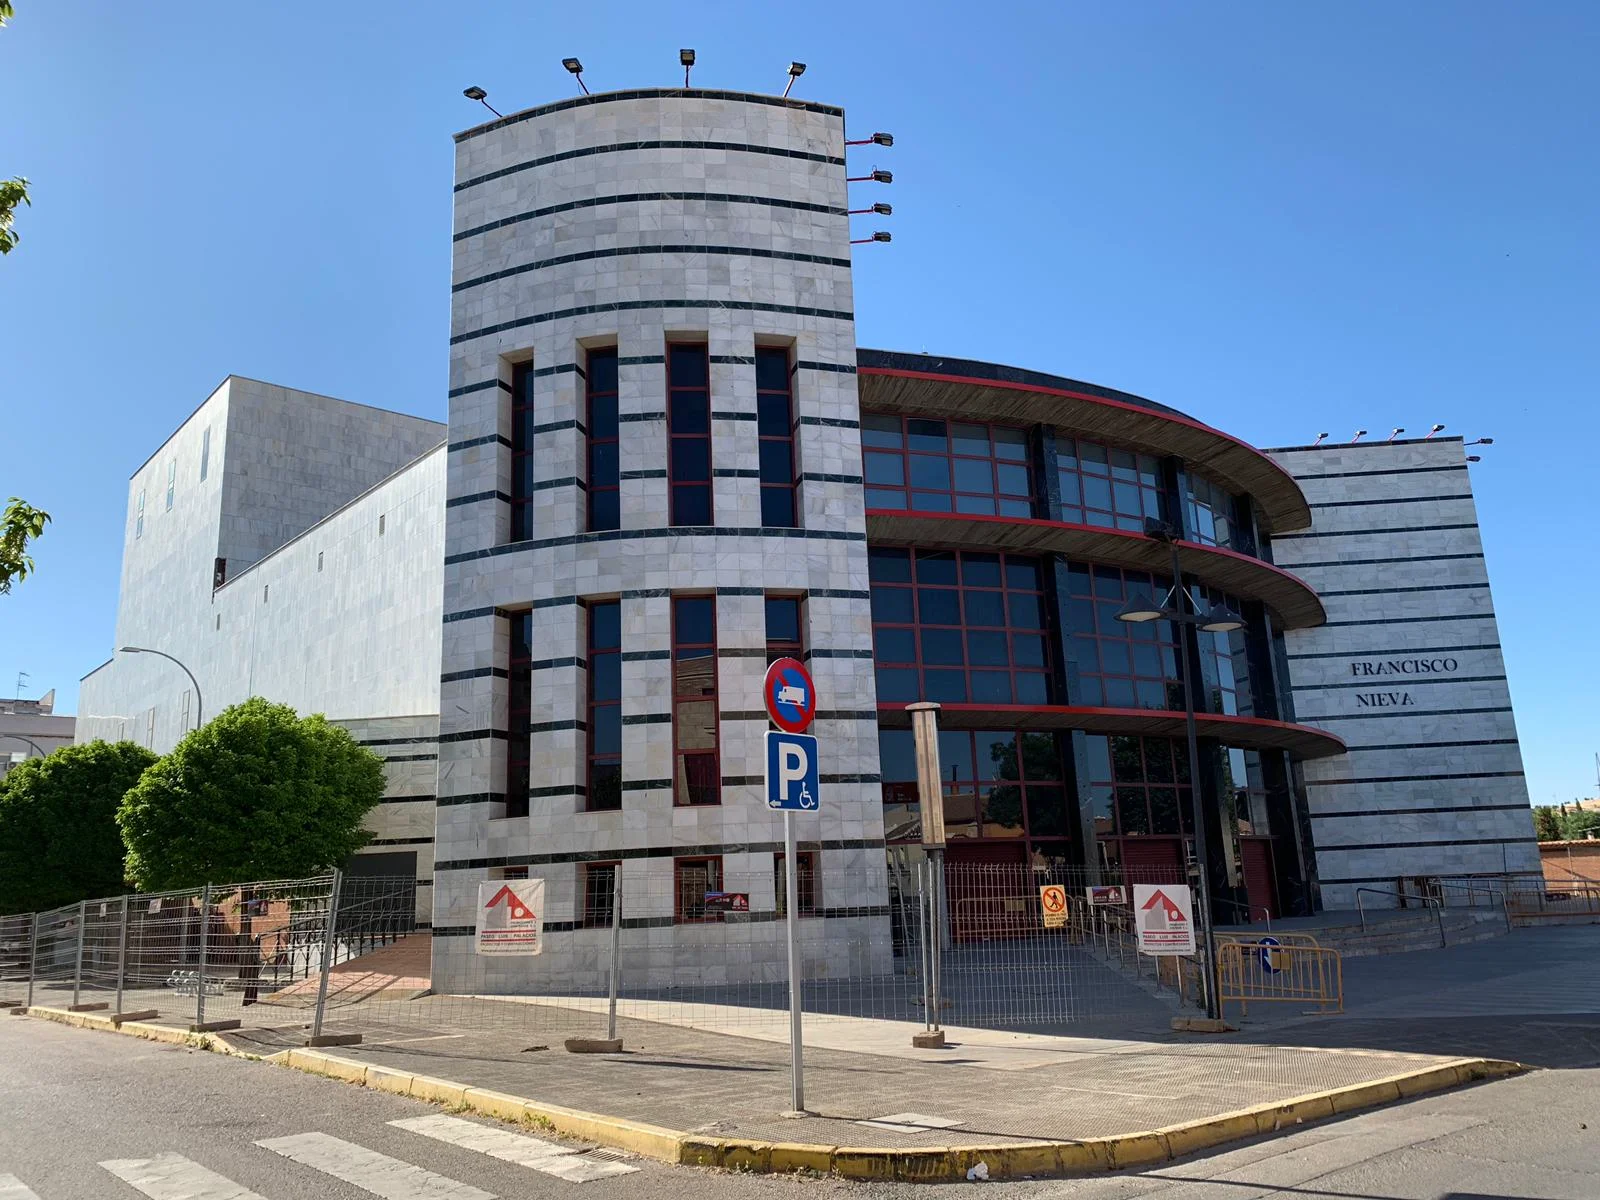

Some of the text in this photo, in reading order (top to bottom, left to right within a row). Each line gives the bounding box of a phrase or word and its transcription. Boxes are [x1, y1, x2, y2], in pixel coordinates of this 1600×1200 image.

[1351, 658, 1458, 676] FRANCISCO
[1356, 692, 1414, 707] NIEVA
[778, 741, 808, 800] P
